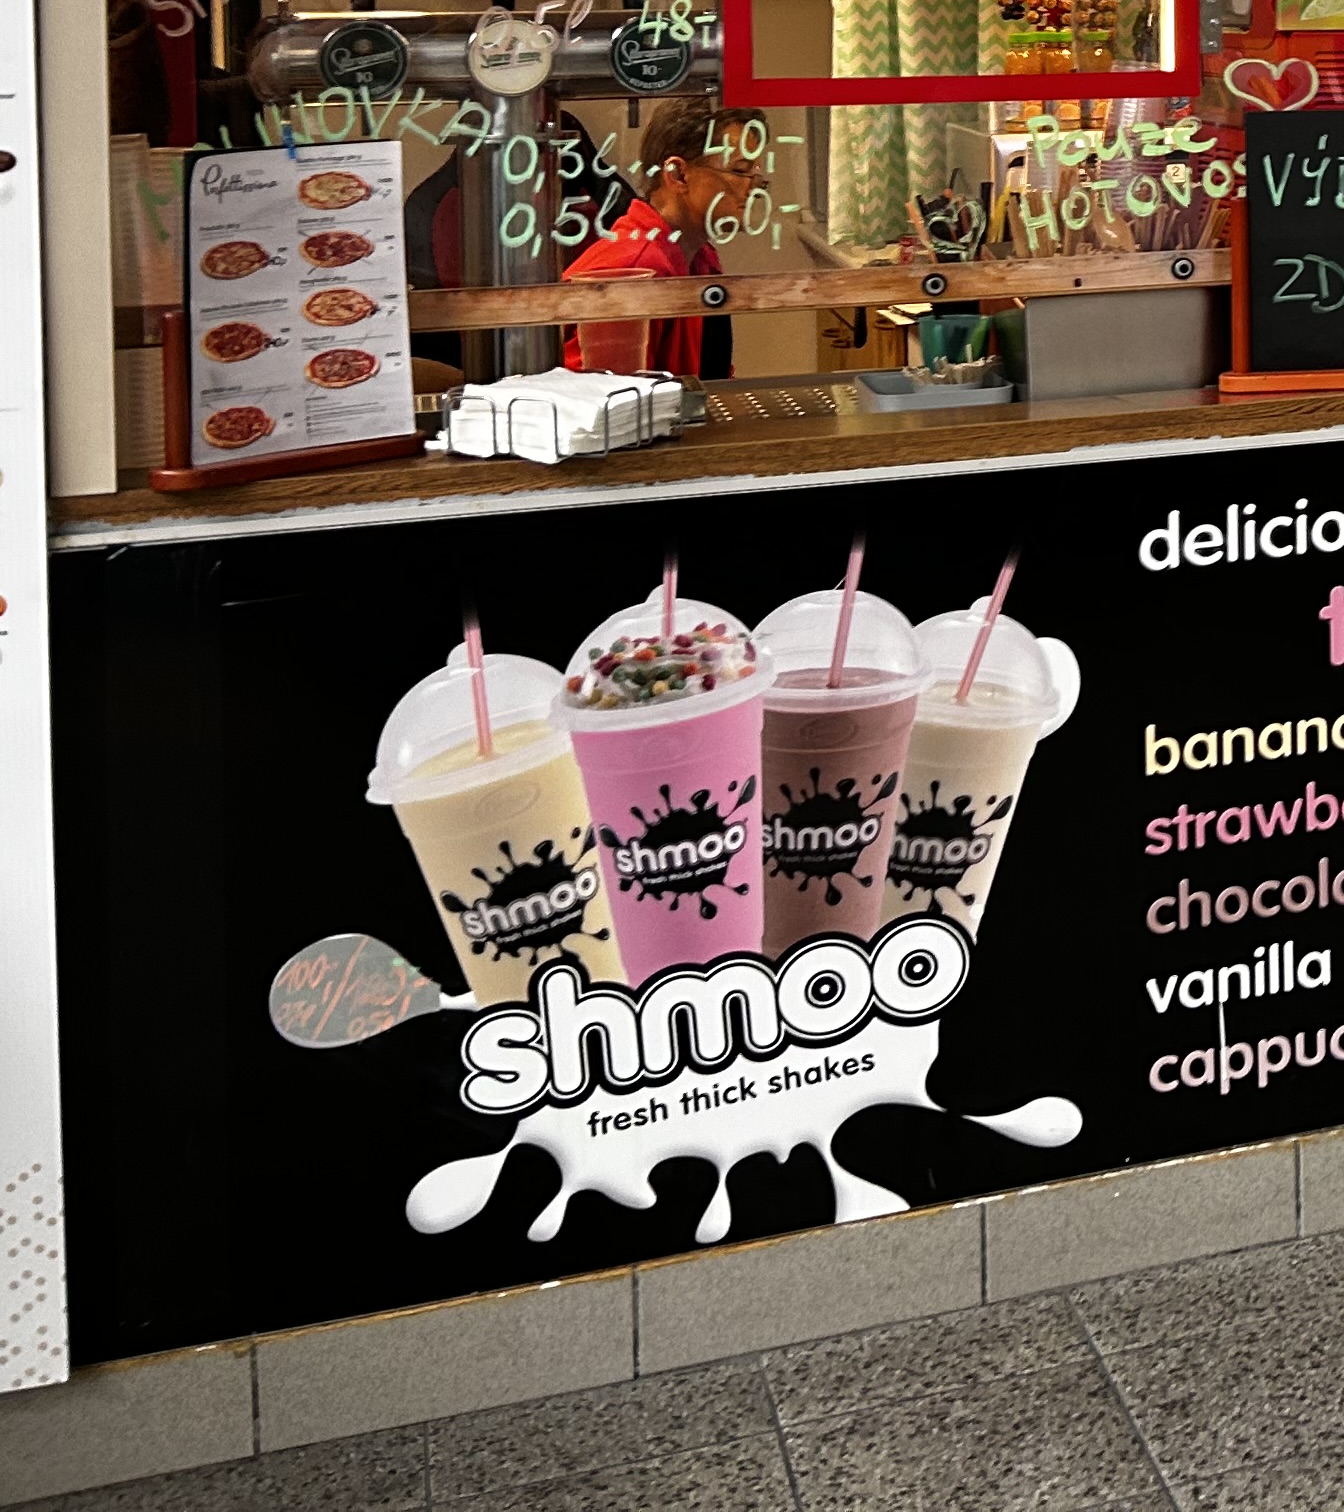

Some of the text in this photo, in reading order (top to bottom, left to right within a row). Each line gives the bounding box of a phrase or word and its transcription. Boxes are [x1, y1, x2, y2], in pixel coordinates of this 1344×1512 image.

[615, 823, 747, 875] shmoo
[461, 868, 600, 940] shmoo
[1146, 940, 1332, 1014] vanilla
[461, 919, 970, 1114] shmoo
[585, 1051, 876, 1137] fresh thick shakes
